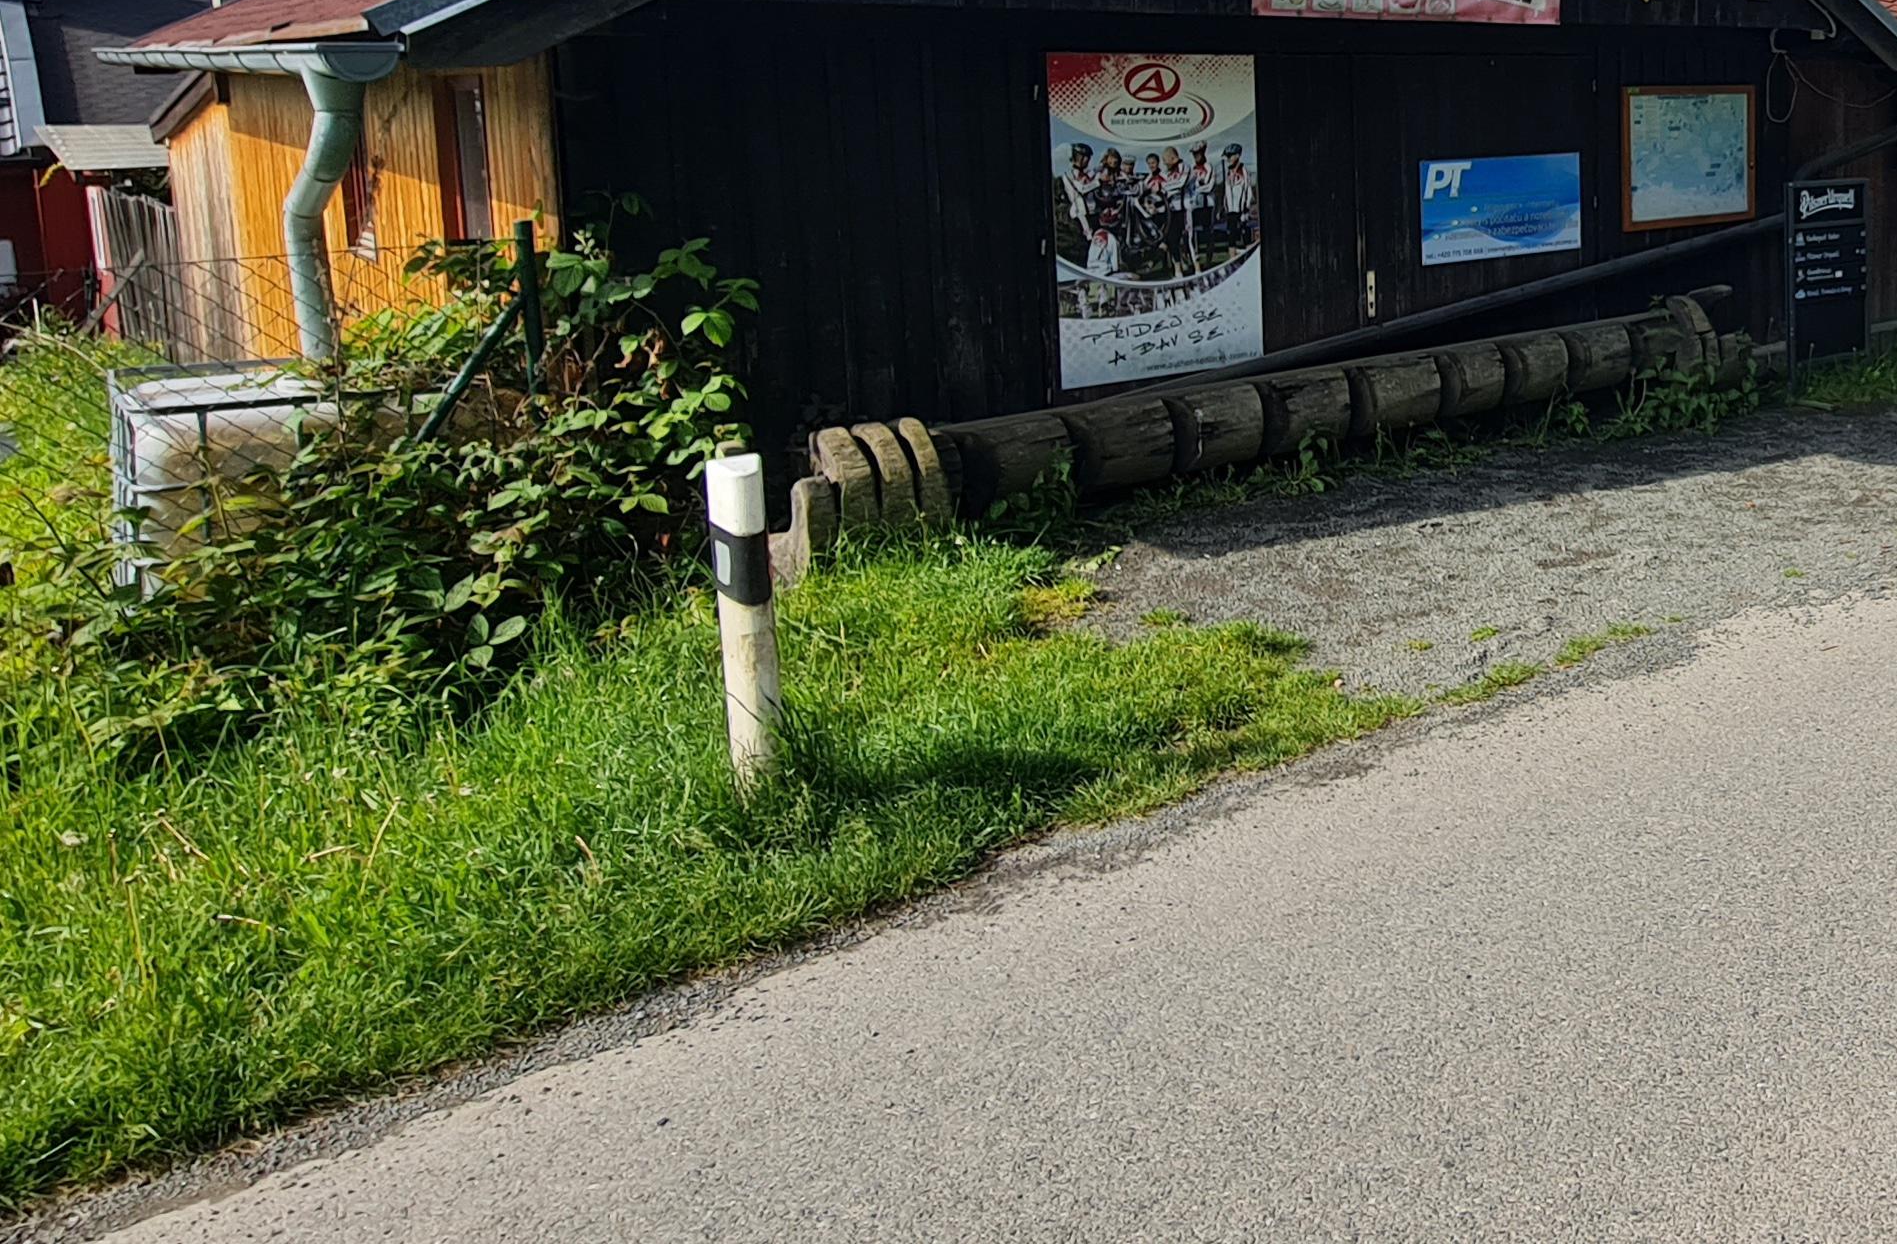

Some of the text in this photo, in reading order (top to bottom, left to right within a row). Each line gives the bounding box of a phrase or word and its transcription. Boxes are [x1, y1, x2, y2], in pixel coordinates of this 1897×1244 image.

[1114, 106, 1189, 116] AUTHOR
[1423, 161, 1472, 200] PT
[1192, 307, 1223, 324] SE
[1108, 350, 1127, 367] A
[1132, 334, 1178, 356] BAV
